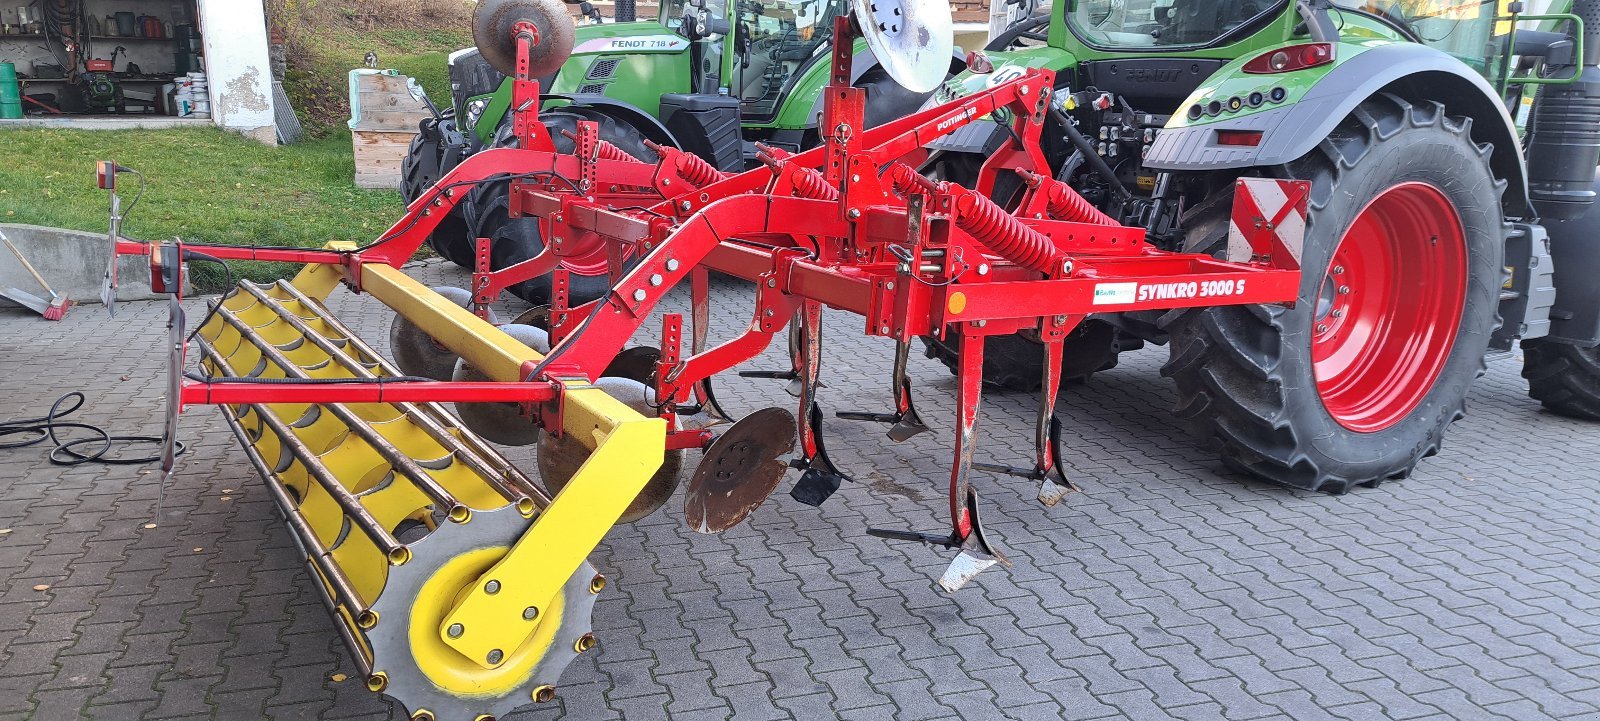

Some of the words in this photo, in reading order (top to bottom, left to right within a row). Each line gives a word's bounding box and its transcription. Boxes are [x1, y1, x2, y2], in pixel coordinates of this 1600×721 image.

[611, 40, 646, 48] FENDT
[650, 40, 666, 48] 718
[1124, 67, 1183, 83] FENDT
[1138, 281, 1198, 301] SYNKRO
[1200, 279, 1235, 297] 3000
[1235, 279, 1246, 295] S
